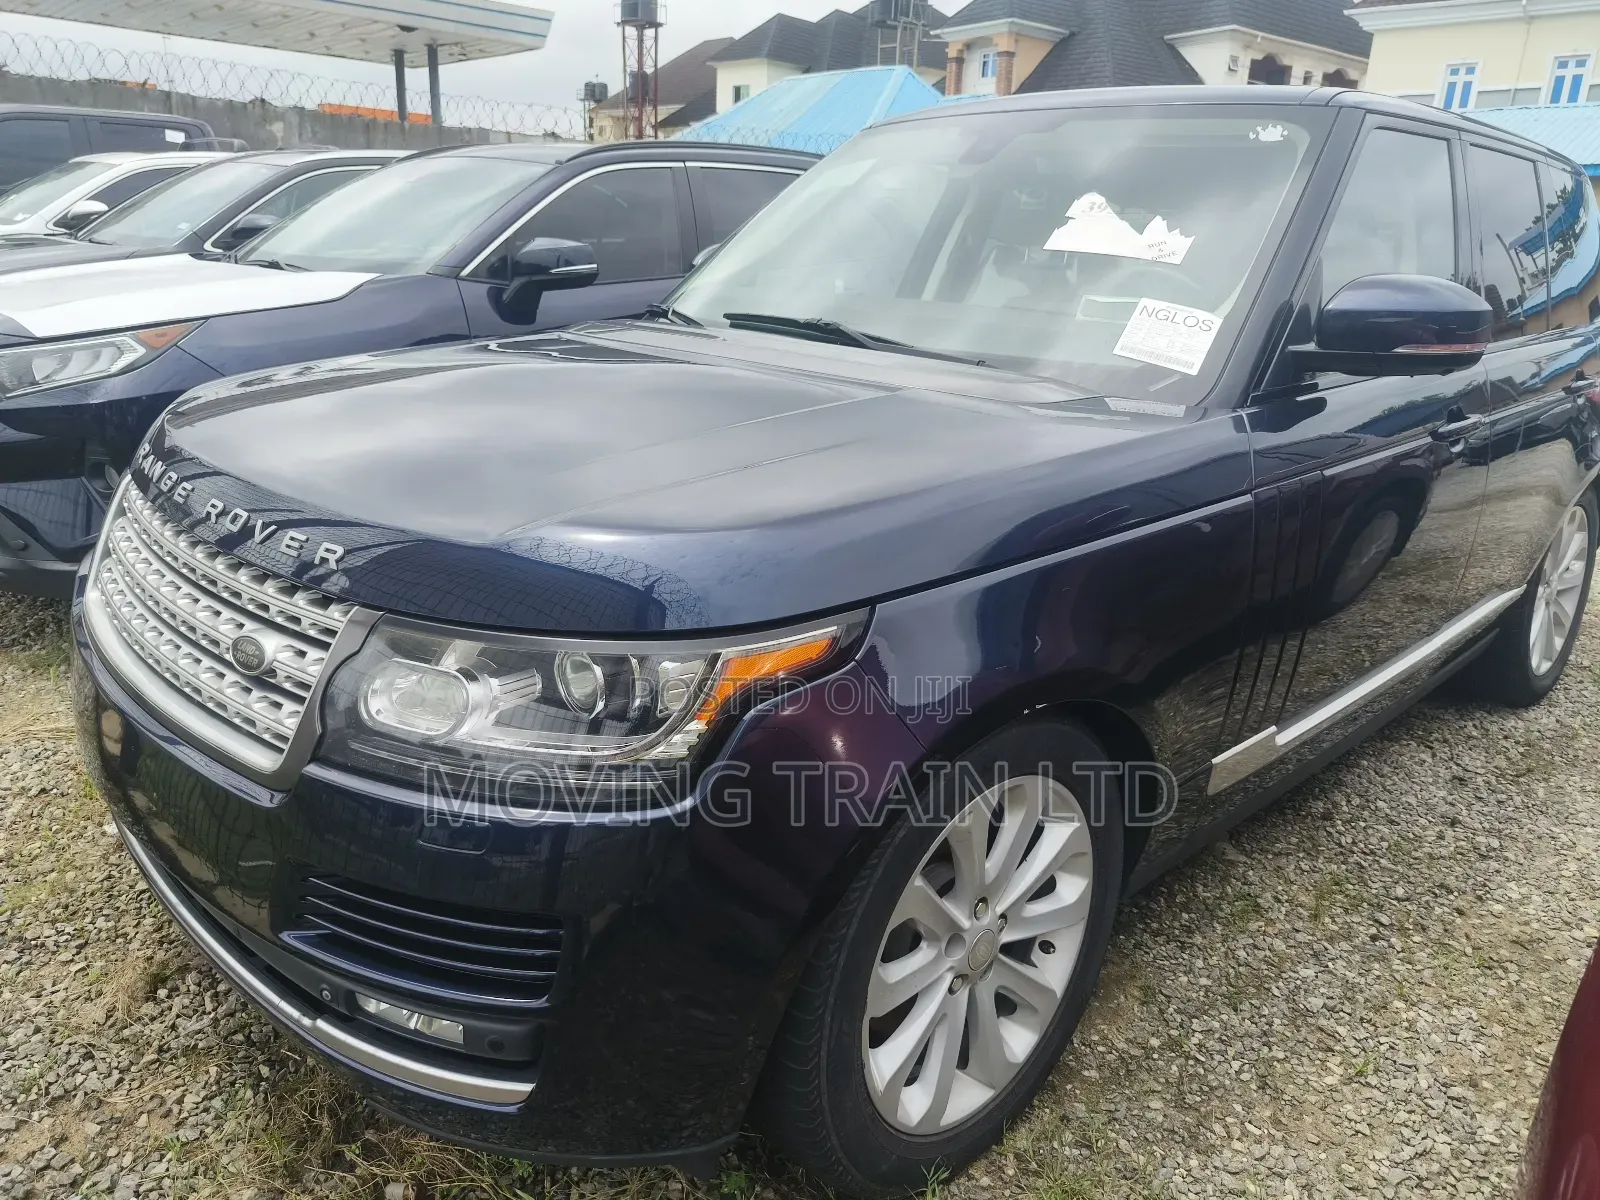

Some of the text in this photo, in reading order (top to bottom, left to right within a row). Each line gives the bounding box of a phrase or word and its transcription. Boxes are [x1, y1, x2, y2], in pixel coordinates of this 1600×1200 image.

[1147, 240, 1167, 249] RUN
[1151, 250, 1178, 261] DRIVE
[1139, 305, 1214, 332] NGLOS
[137, 442, 346, 570] RANGE ROVER
[237, 640, 256, 656] LAND
[235, 650, 259, 668] ROVER
